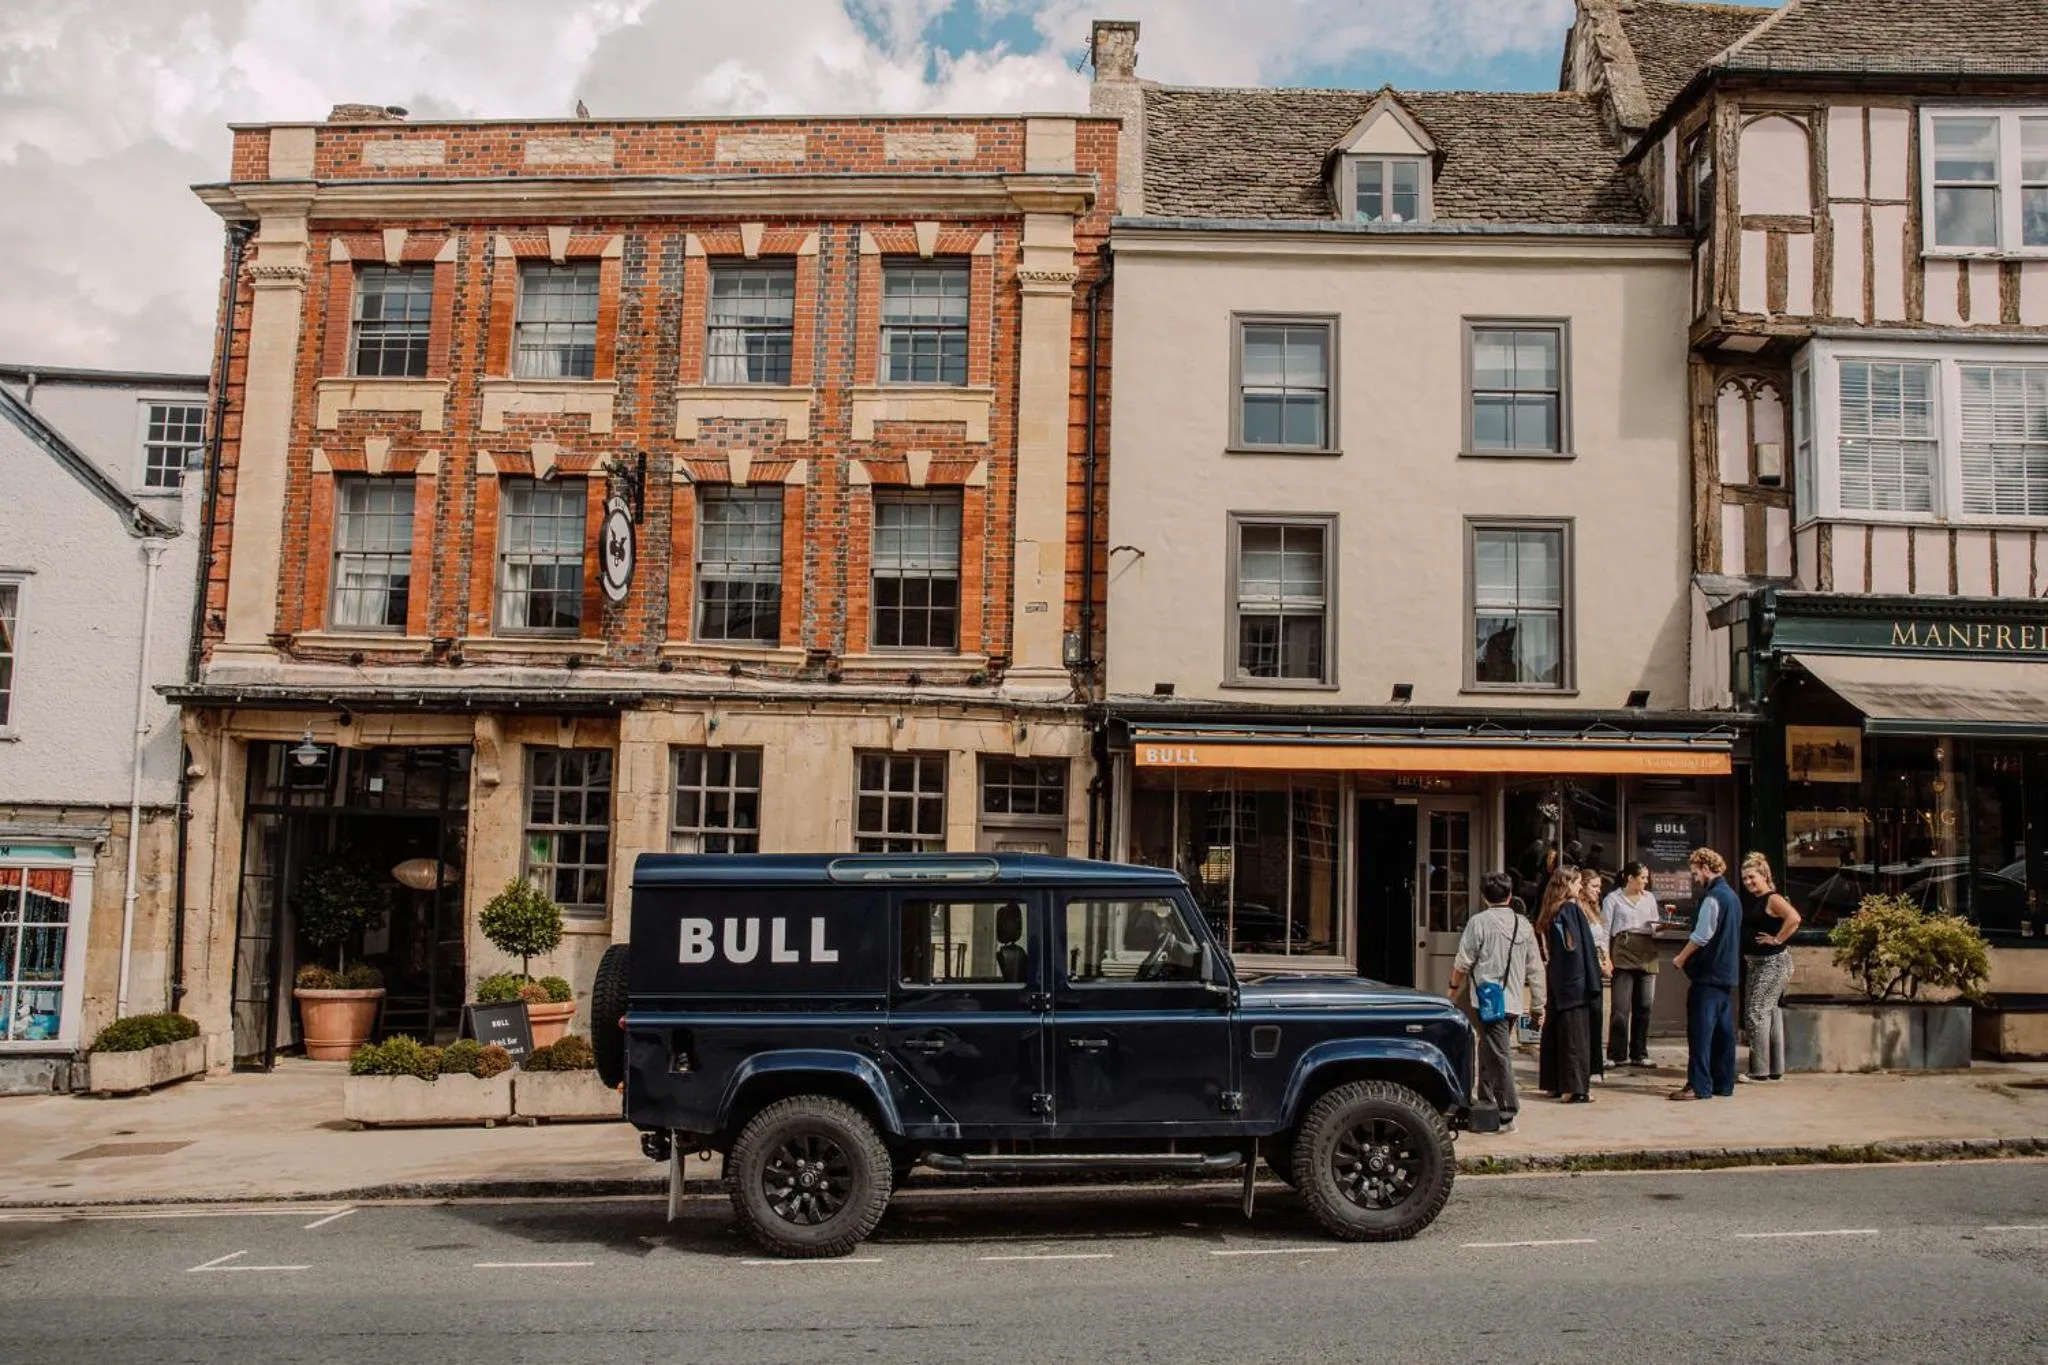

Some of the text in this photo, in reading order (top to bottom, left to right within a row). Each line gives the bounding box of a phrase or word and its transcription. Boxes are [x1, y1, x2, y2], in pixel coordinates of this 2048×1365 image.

[1147, 748, 1199, 763] BULL
[1796, 804, 1957, 826] PORTING
[1655, 823, 1687, 834] BULL
[678, 916, 840, 964] BULL
[492, 1019, 510, 1028] BULL
